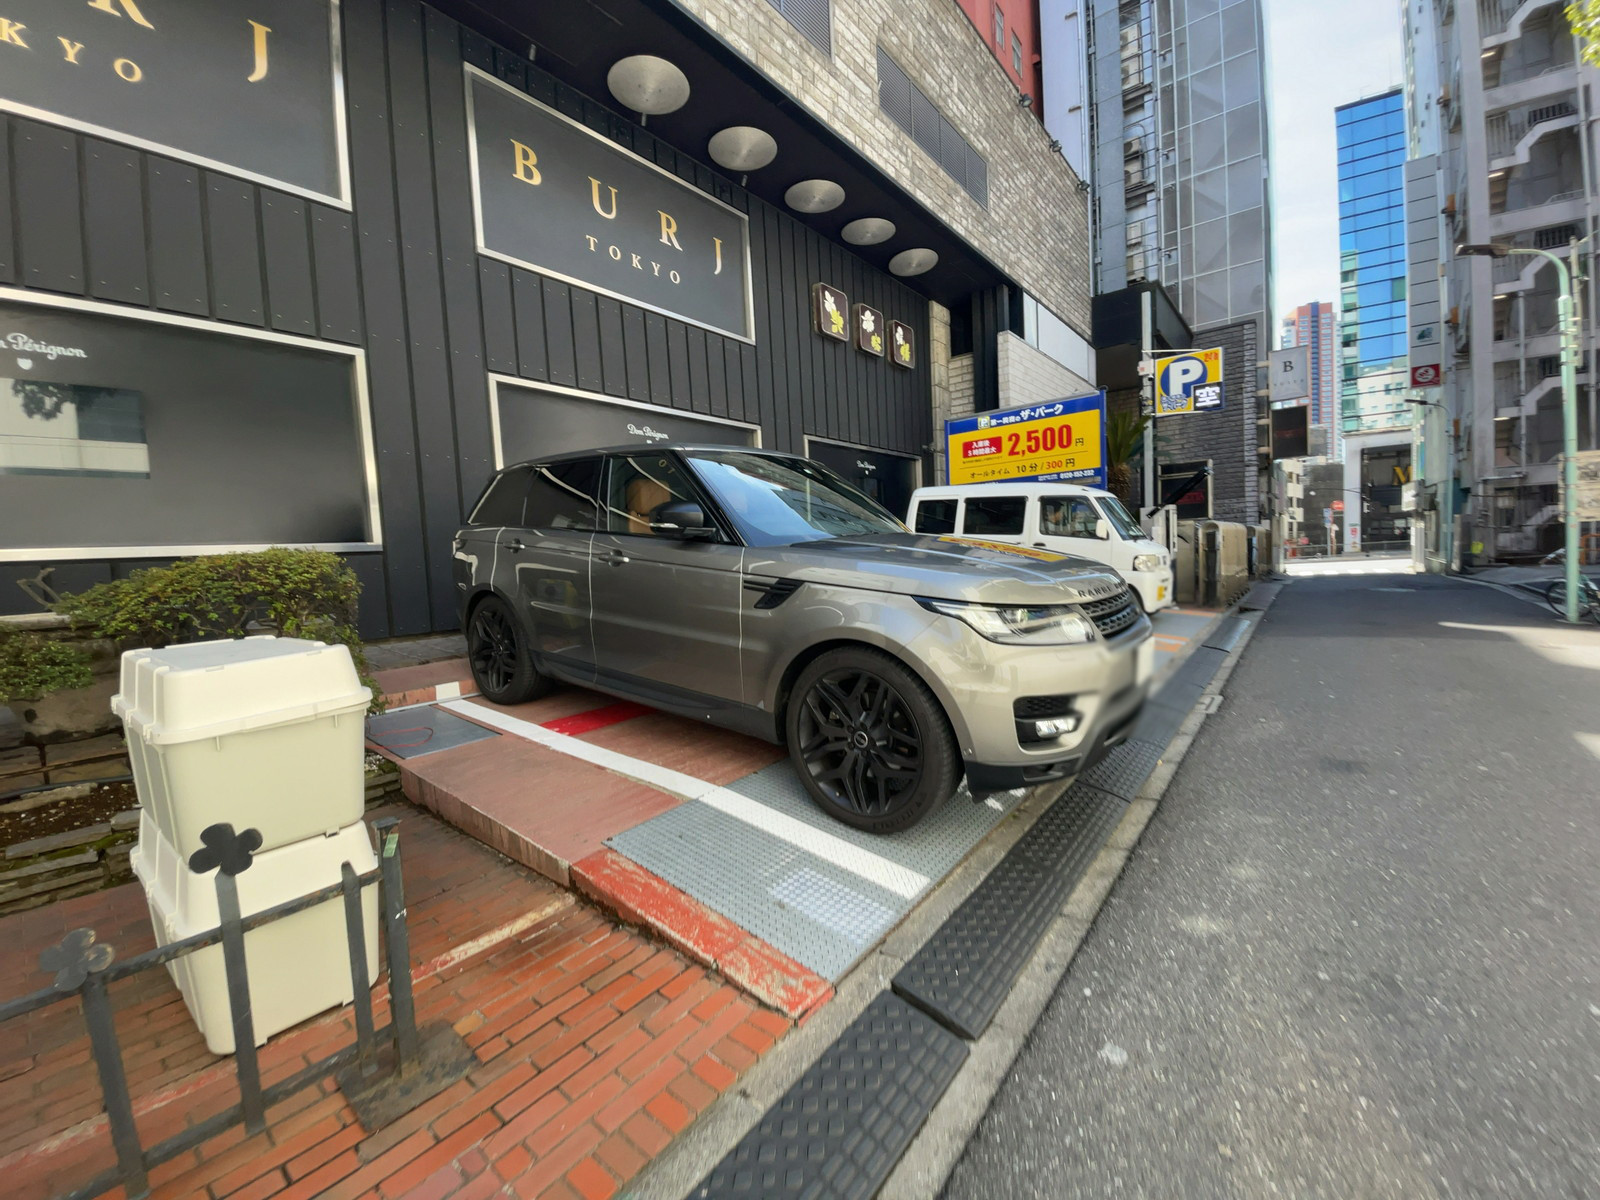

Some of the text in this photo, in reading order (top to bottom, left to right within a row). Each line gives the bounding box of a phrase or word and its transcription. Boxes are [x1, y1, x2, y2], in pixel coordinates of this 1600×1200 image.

[510, 138, 723, 276] BURJ
[585, 234, 681, 285] TOKYO
[1169, 359, 1204, 397] P
[1282, 360, 1295, 373] B
